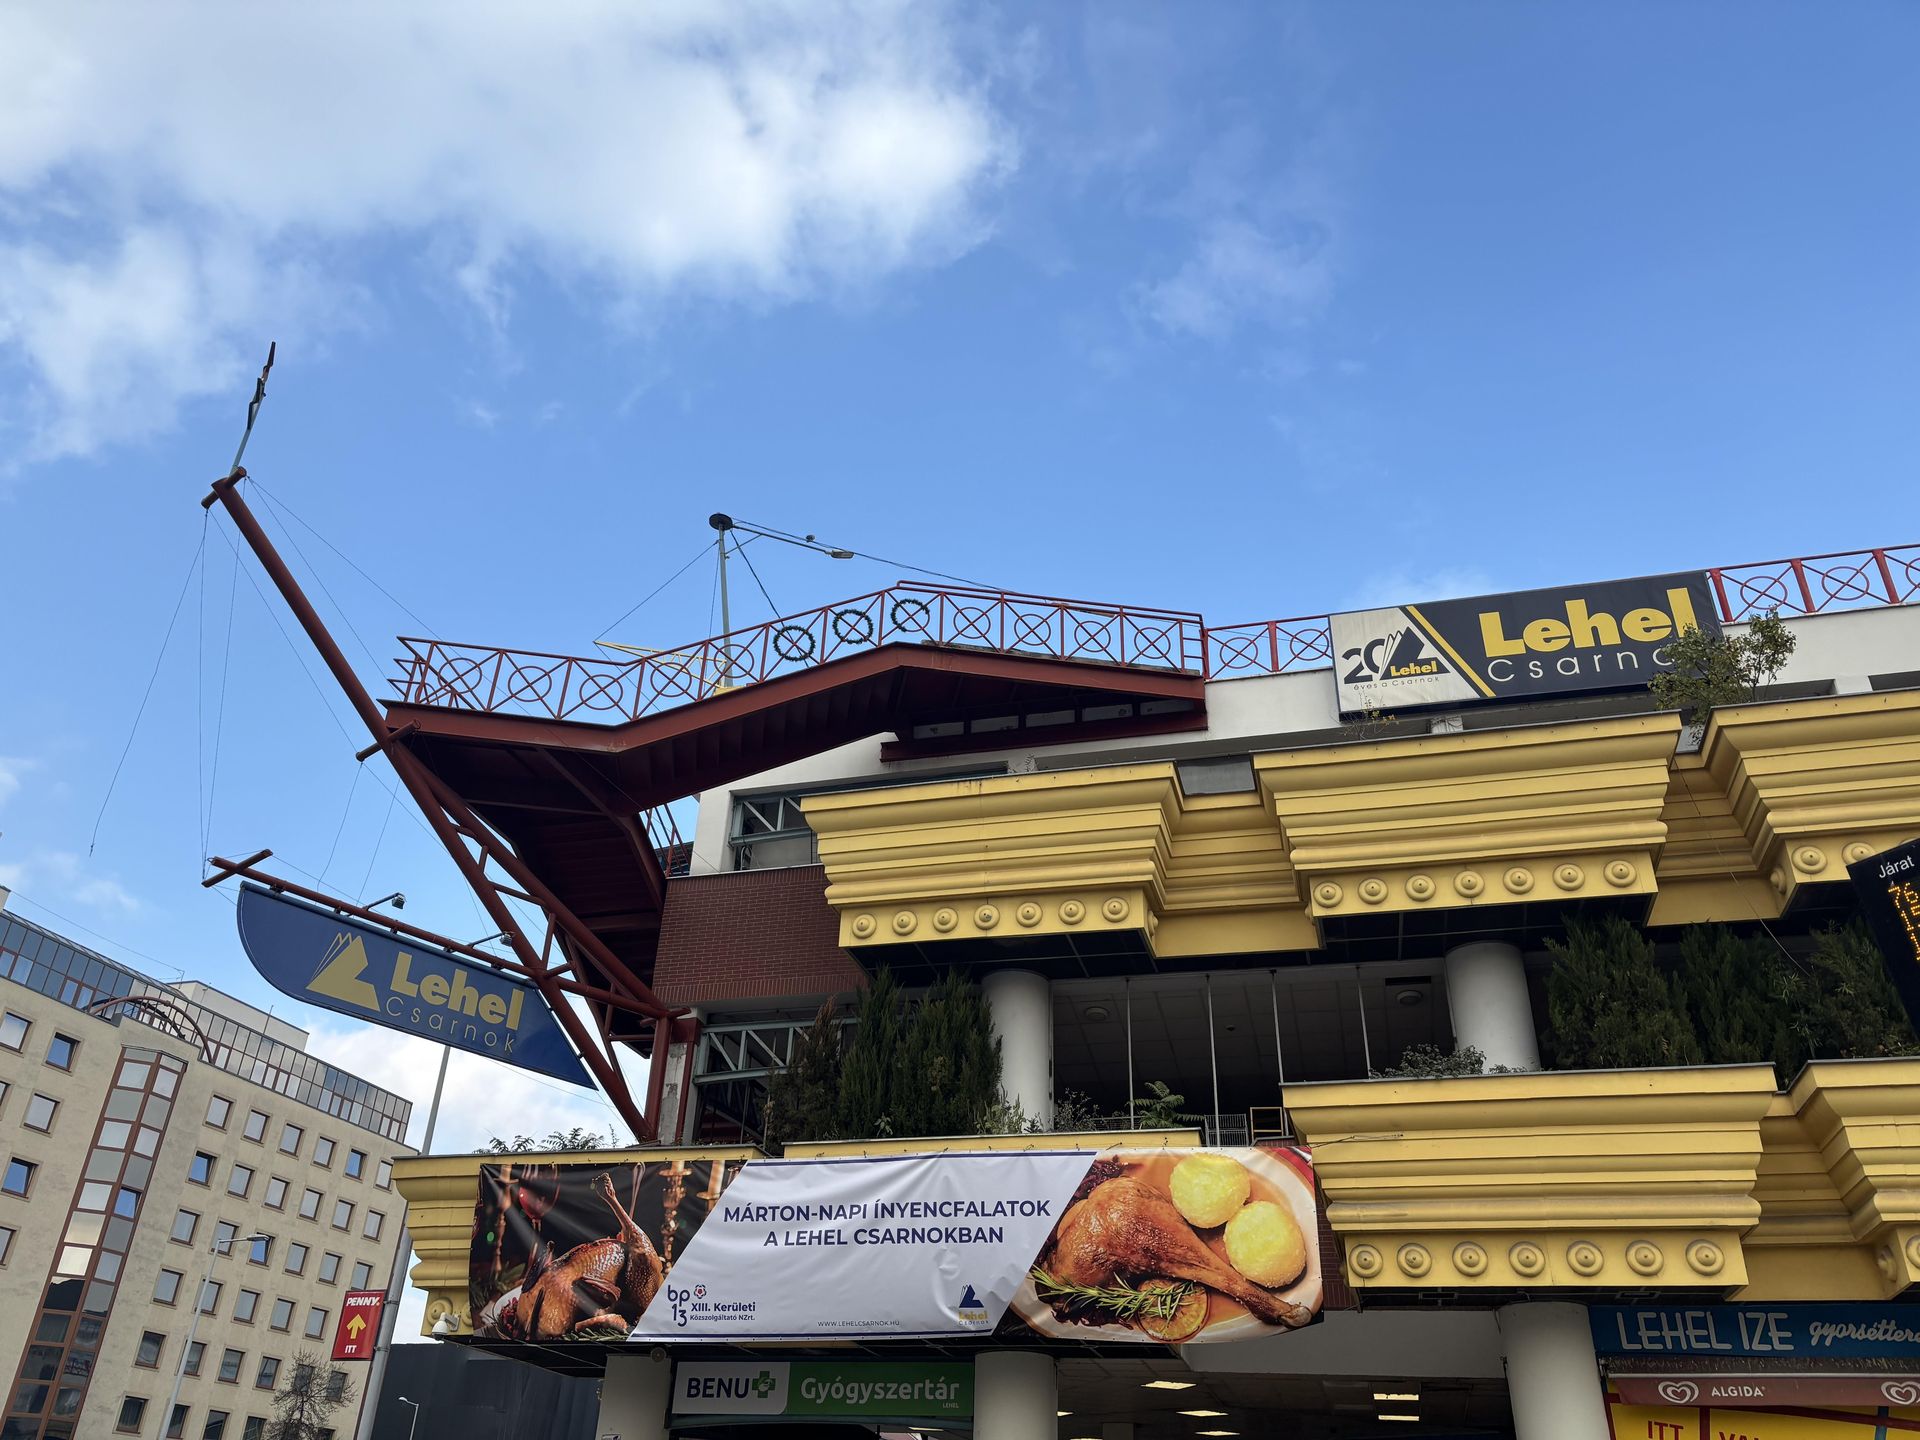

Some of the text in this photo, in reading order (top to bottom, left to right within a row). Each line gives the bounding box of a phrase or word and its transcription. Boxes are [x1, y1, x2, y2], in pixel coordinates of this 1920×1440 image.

[1479, 588, 1699, 658] Lehel
[1390, 661, 1438, 677] Lehel
[1488, 645, 1677, 682] Csarno
[1392, 676, 1440, 686] Csarnok
[1878, 855, 1915, 878] Járat
[389, 951, 525, 1030] Lehel
[386, 996, 514, 1053] Csarnok
[723, 1199, 1051, 1222] MÁRTON-NAPI ÍNYENCFALATOK
[764, 1226, 1004, 1247] A LEHEL CSARNOKBAN
[667, 1285, 690, 1307] bp
[691, 1302, 756, 1312] XIII. Kerületi
[1616, 1311, 1733, 1350] LEHEL
[1738, 1312, 1794, 1351] IZE
[344, 1344, 357, 1354] ITT
[686, 1375, 960, 1404] BENU Gyógyszertár
[1711, 1385, 1764, 1397] ALGIDA
